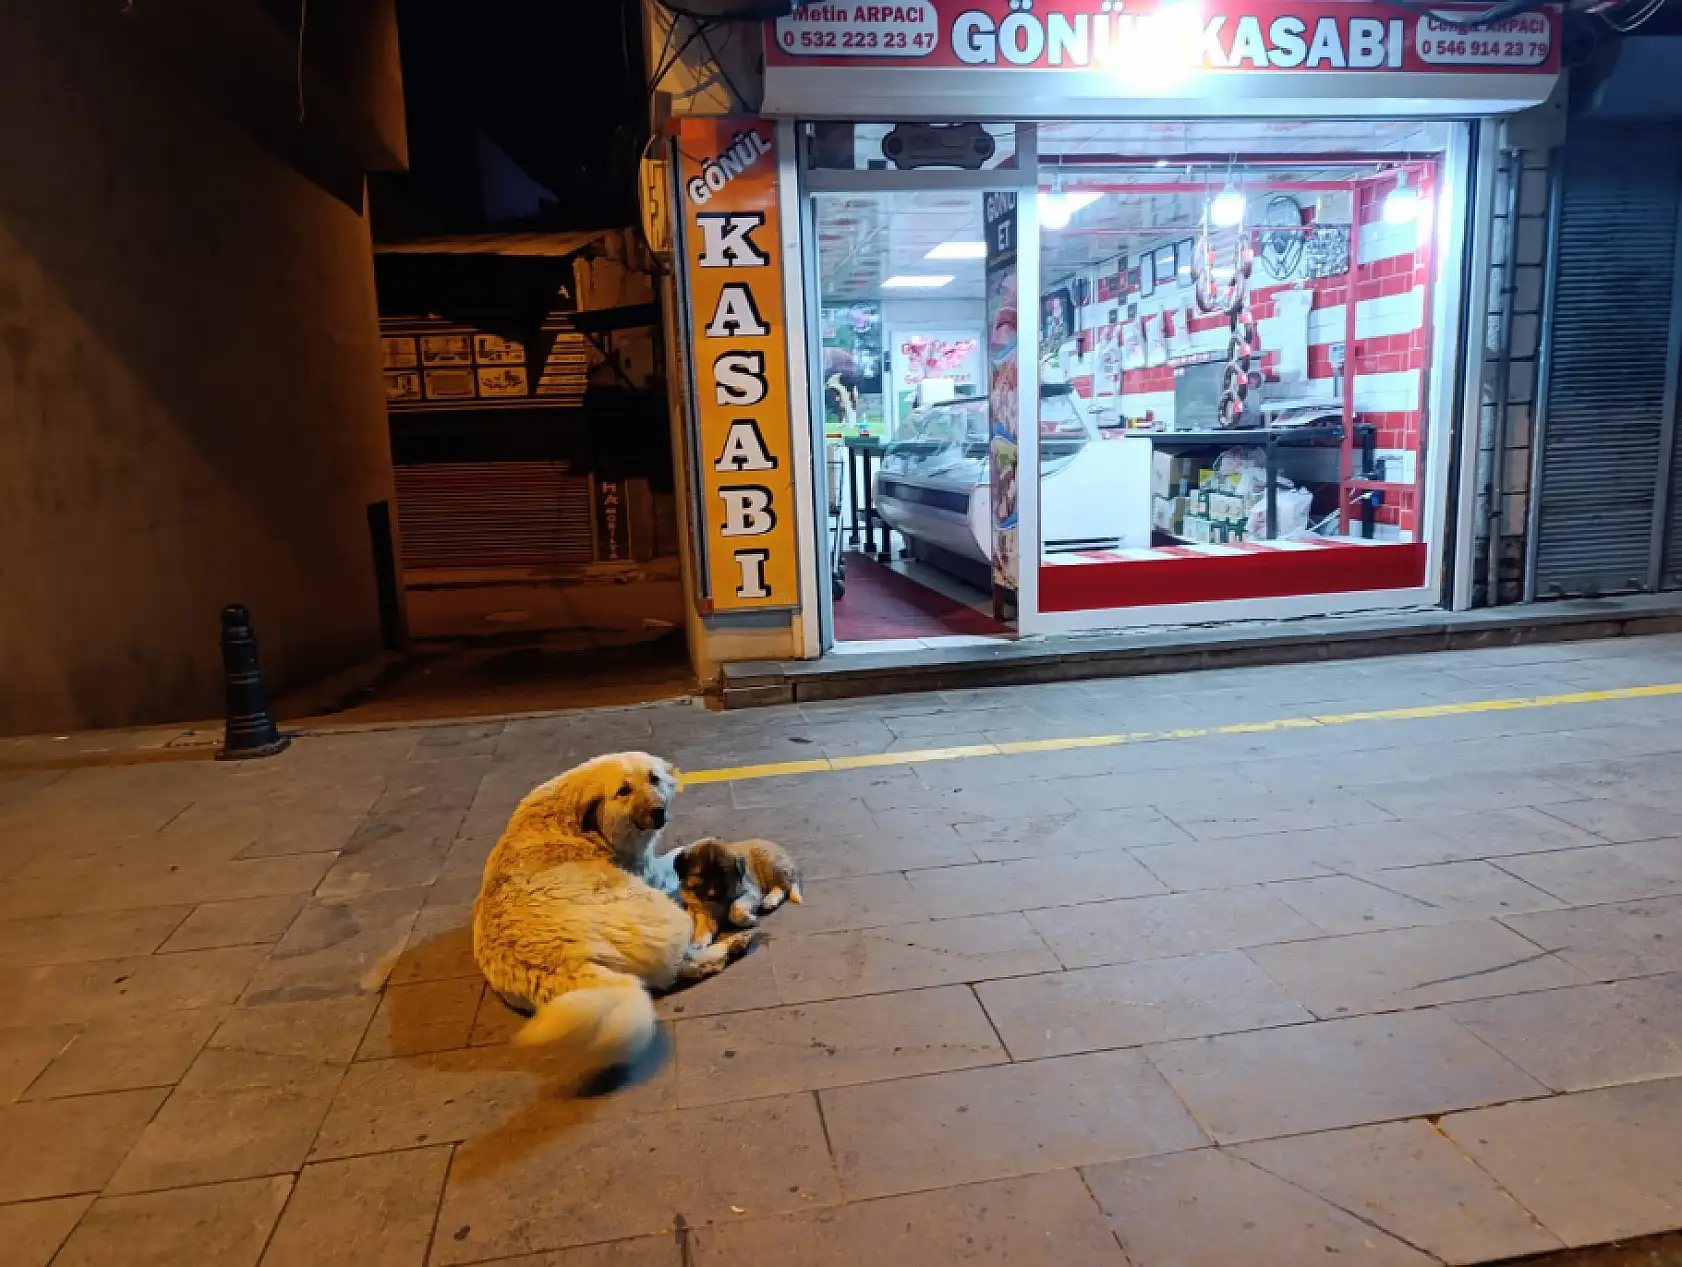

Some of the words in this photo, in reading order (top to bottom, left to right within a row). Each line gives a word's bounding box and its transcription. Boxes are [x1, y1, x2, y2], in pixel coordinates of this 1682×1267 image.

[793, 5, 848, 23] Metin
[854, 6, 925, 23] ARPACI
[951, 0, 1180, 66] GÖNÜ
[1188, 14, 1404, 68] KASABI
[783, 31, 795, 47] 0
[800, 31, 837, 48] 532
[842, 32, 879, 48] 223
[883, 32, 907, 49] 23
[912, 32, 935, 49] 47
[1422, 39, 1432, 55] 0
[1436, 40, 1466, 56] 546
[1470, 41, 1500, 56] 914
[1504, 42, 1524, 57] 23
[1528, 42, 1548, 57] 79
[687, 128, 772, 206] GÖNÜL
[696, 211, 779, 598] KASABI
